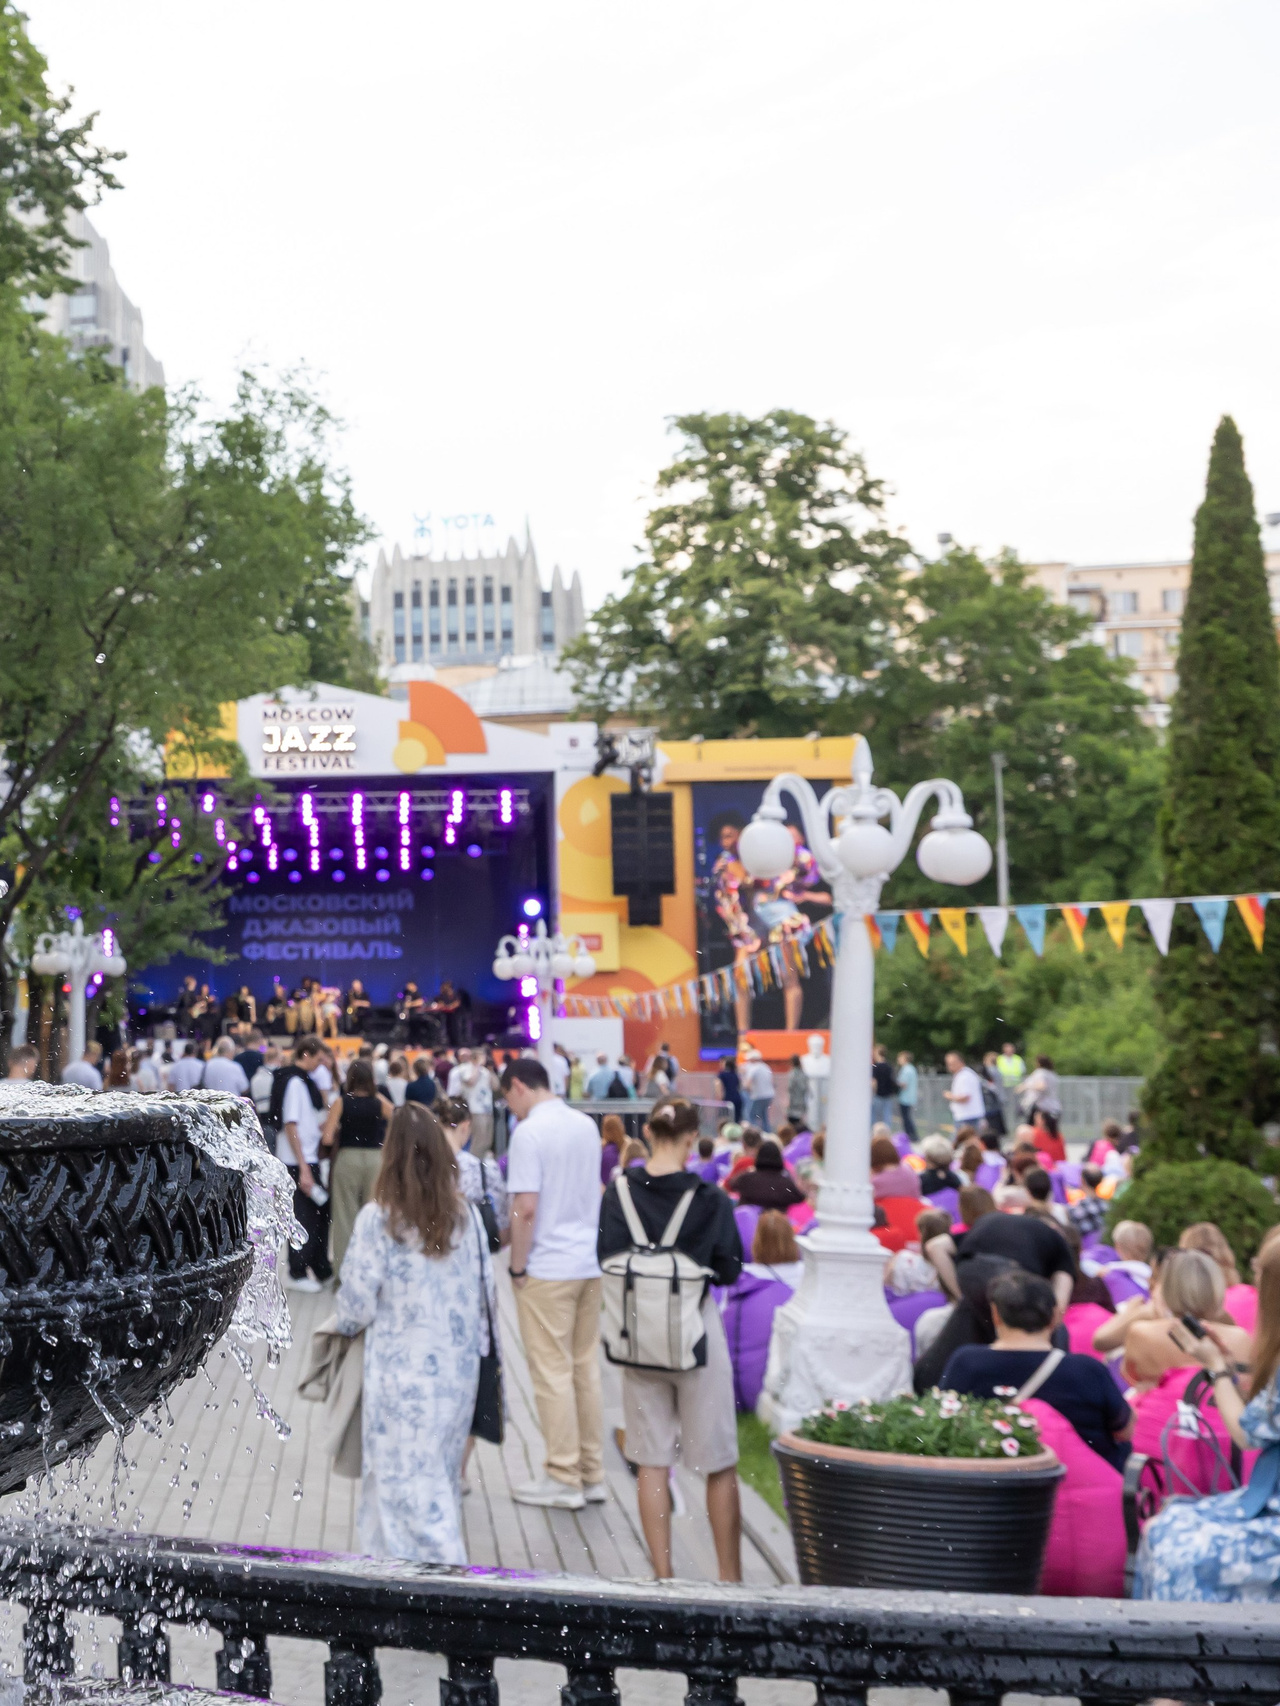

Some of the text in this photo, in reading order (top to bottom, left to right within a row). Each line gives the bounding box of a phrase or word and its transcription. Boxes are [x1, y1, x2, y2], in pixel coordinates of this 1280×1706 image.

[441, 513, 495, 529] YOTA
[263, 708, 354, 721] MOSCOW
[262, 724, 357, 752] JAZZ
[264, 757, 354, 770] FESTIVAL
[230, 889, 414, 912] МОСКОВСКИЙ
[242, 913, 401, 939] ДЖАЗОВЫЙ
[242, 941, 403, 960] ФЕСТИВАЛЬ
